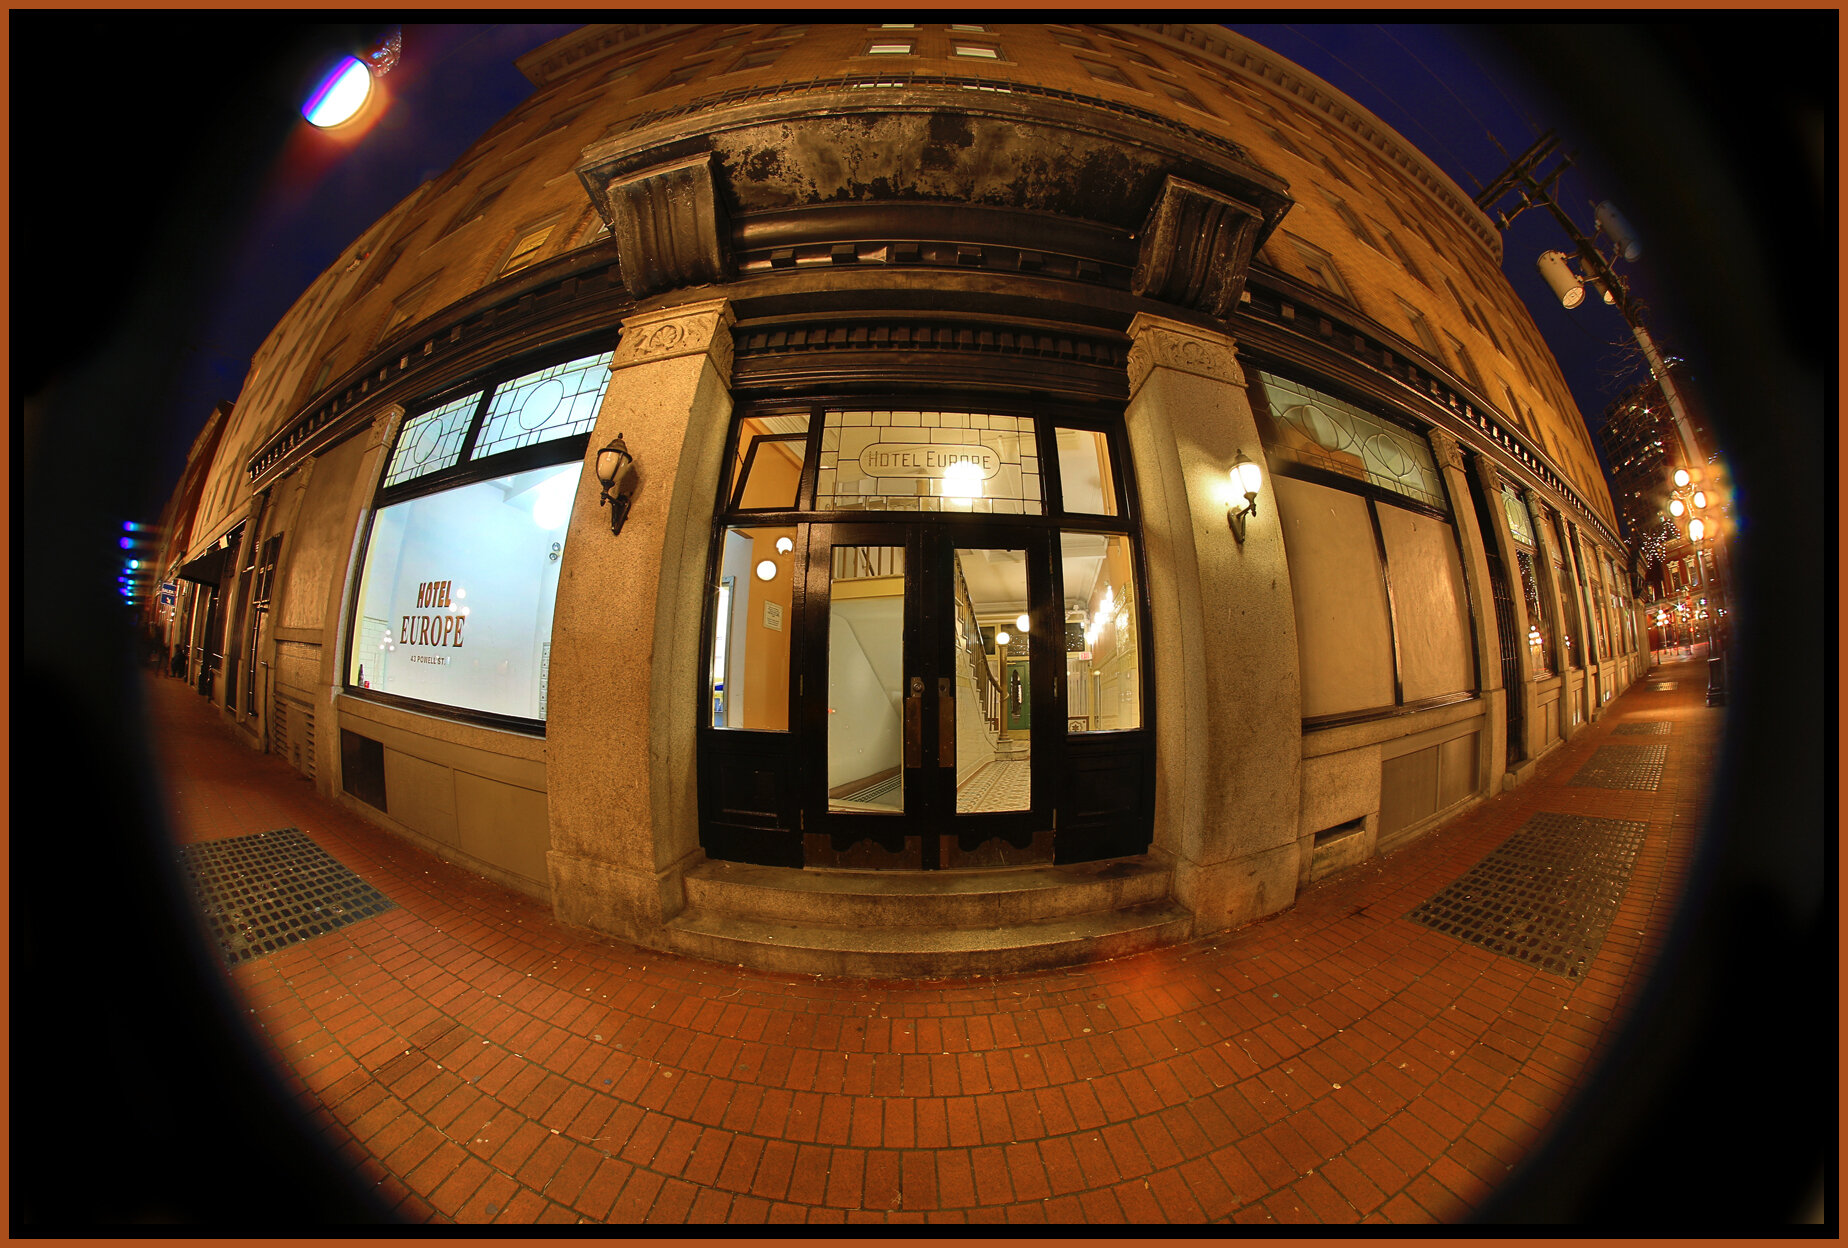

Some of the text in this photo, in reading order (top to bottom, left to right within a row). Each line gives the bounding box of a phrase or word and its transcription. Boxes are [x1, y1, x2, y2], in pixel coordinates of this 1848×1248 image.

[868, 450, 921, 468] HOTEL
[416, 580, 453, 609] HOTEL
[399, 615, 466, 648] EUROPE
[410, 655, 417, 663] 43
[417, 655, 437, 665] POWELL
